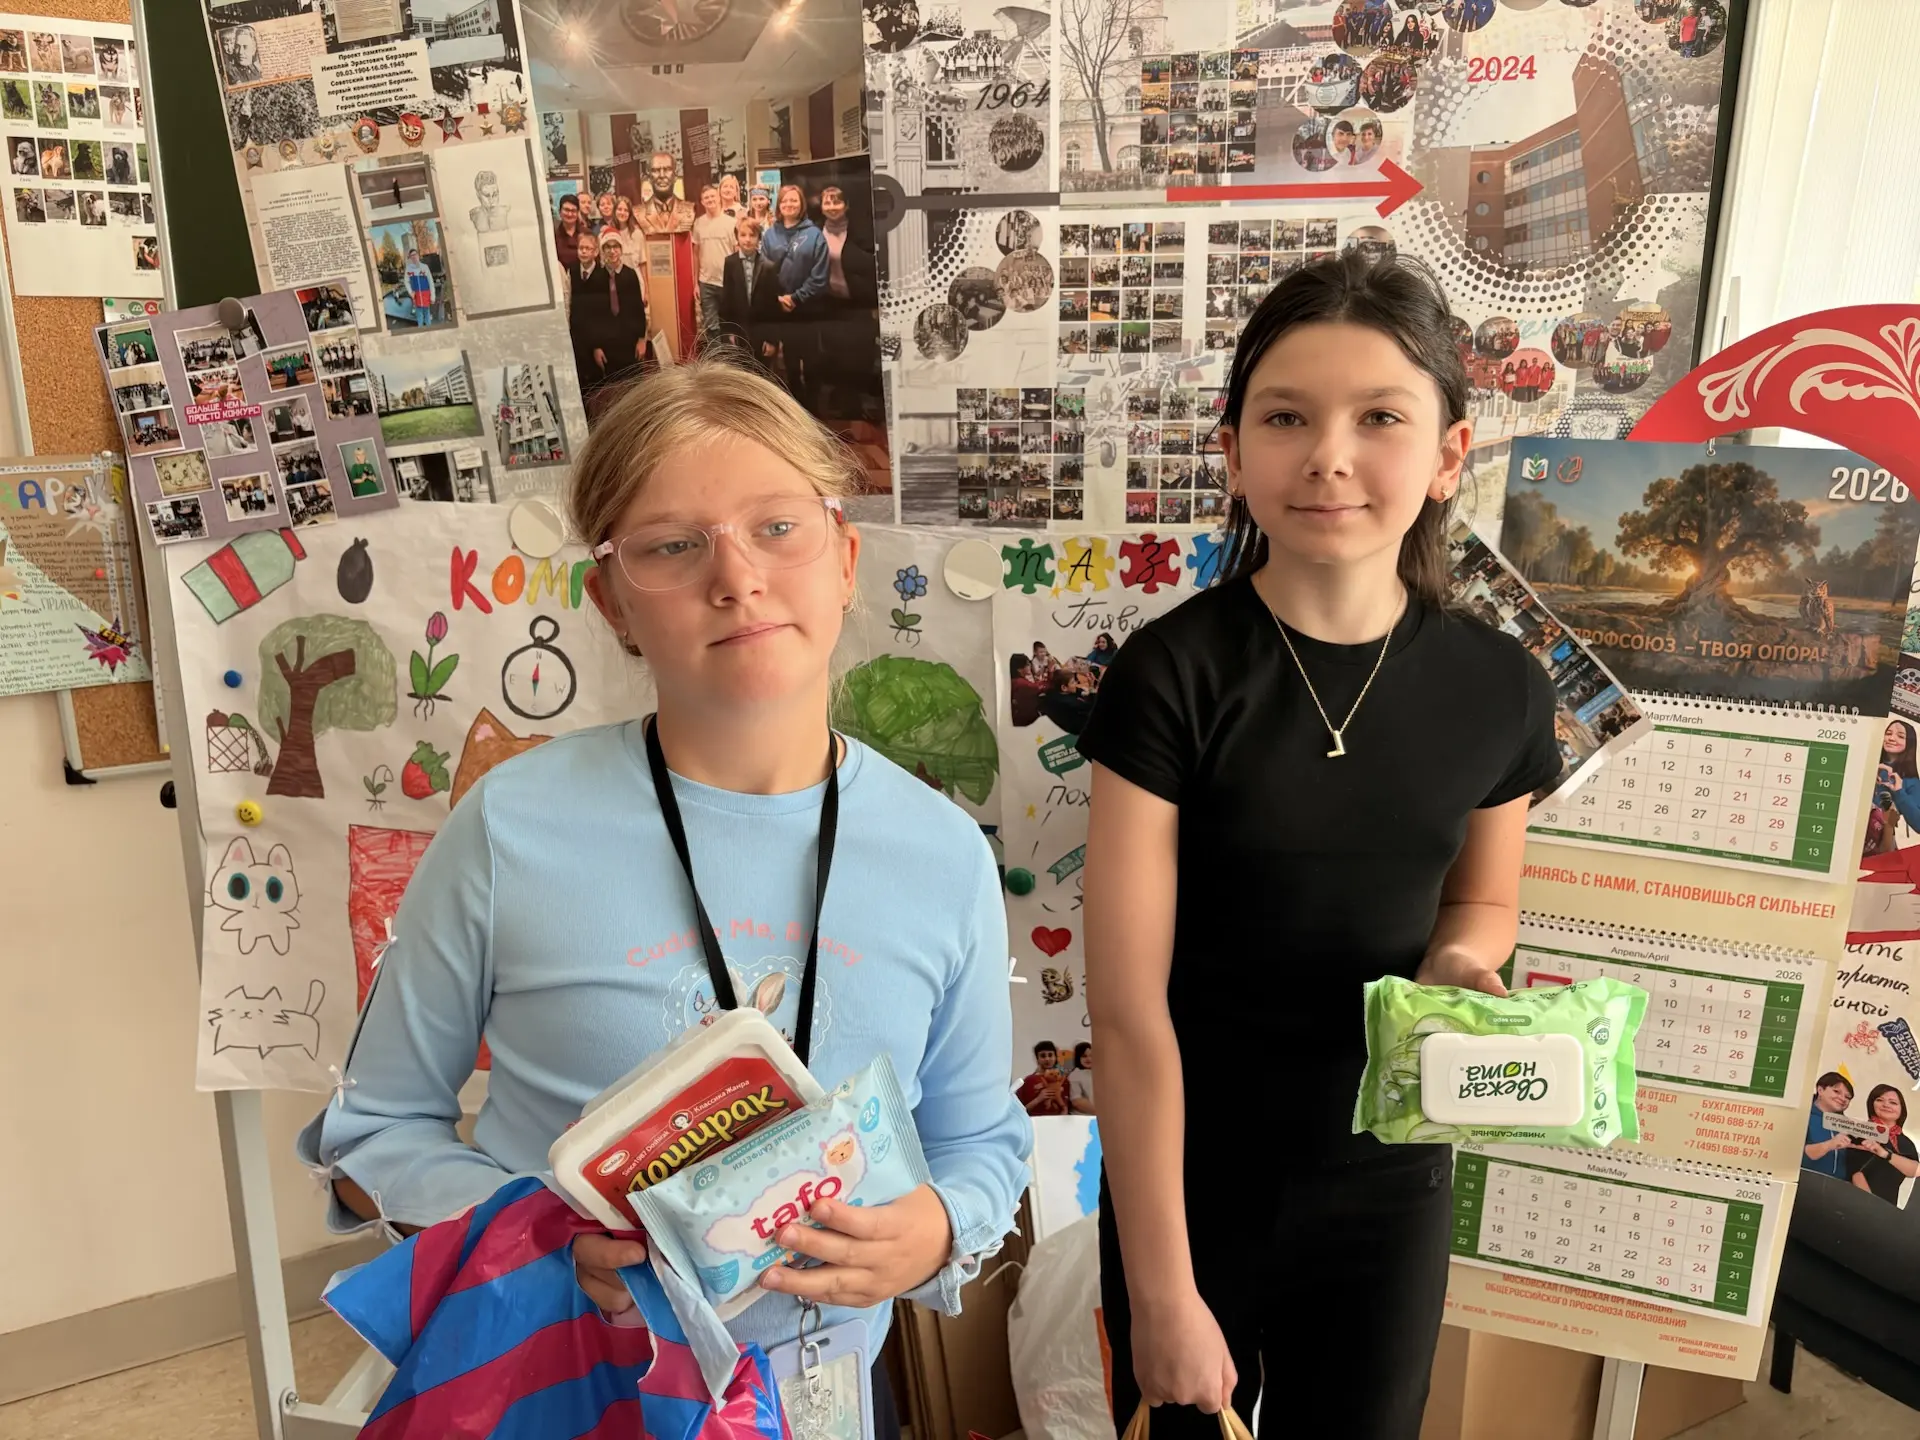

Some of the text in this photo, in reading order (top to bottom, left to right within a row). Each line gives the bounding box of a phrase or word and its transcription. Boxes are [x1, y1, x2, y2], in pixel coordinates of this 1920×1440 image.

[322, 51, 418, 72] Николай Эрастович Берзарин
[338, 46, 397, 60] Проект памятника
[331, 69, 413, 87] Советский военачальник,
[1467, 55, 1537, 83] 2024
[328, 76, 419, 96] первый комендант Берлина.
[975, 79, 1051, 111] 1964
[336, 93, 418, 111] Герой Советского Союза.
[224, 400, 239, 409] ЧЕМ
[188, 412, 221, 423] ПРОСТО
[1828, 466, 1910, 504] 2026
[536, 651, 543, 660] N
[1700, 640, 1752, 660] ТВОЯ
[1758, 644, 1827, 664] ОПОРА!
[510, 674, 516, 685] E
[1667, 740, 1674, 750] 5
[1817, 729, 1846, 741] 2026
[1625, 757, 1792, 785] 11 12 13 14 15
[1622, 779, 1788, 807] 18 19 20 21 22
[1544, 813, 1592, 827] 30 31
[1581, 796, 1785, 830] 24 25 26 27 28 29
[1520, 863, 1836, 919] ИНЯЯСЬ С НАМИ, СТАНОВИШЬСЯ СИЛЬНЕЕ!
[730, 918, 775, 941] Me,
[1526, 957, 1571, 972] 30 31
[1610, 946, 1670, 963] Апрель/April
[1775, 970, 1803, 981] 2026
[1664, 999, 1751, 1019] 10 11 12
[1661, 1018, 1748, 1040] 17 18 19
[1657, 1039, 1744, 1060] 24 25 26
[1890, 1036, 1919, 1077] СЕРДЦА
[1466, 1061, 1536, 1081] нота
[694, 1080, 750, 1113] Классика Жанра
[1458, 1078, 1549, 1101] Свежая
[1648, 1091, 1677, 1104] ОТДЕЛ
[1702, 1100, 1765, 1117] БУХГАЛТЕРИЯ
[1688, 1112, 1774, 1131] +7 (495) 688-57-74
[628, 1086, 786, 1193] Доширак
[646, 1130, 669, 1152] Doshirak
[775, 1120, 811, 1146] ВЛАЖНЫЕ
[1471, 1130, 1546, 1139] УНИВЕРСАЛЬНЫЕ
[1696, 1128, 1761, 1146] ОПЛАТА ТРУДА
[733, 1144, 774, 1171] САЛФЕТКИ
[1684, 1140, 1769, 1160] +7 (495) 688-57-74
[699, 1172, 715, 1187] 20
[1586, 1163, 1628, 1178] Май/May
[1735, 1189, 1761, 1200] 2026
[751, 1176, 842, 1239] tafo
[1527, 1212, 1744, 1259] 12 13 14 15 16 17 20
[1700, 1225, 1713, 1234] 10
[1492, 1224, 1740, 1279] 18 19 20 21 22 23 24 21
[1488, 1243, 1738, 1300] 25 26 27 28 29 30 31 22
[1502, 1273, 1559, 1292] МОСКОВСКАЯ
[1559, 1284, 1610, 1302] ГОРОДСКАЯ
[1486, 1283, 1687, 1328] ОБЩЕРОССИЙСКОГО ПРОФСОЮЗА ОБРАЗОВАНИЯ
